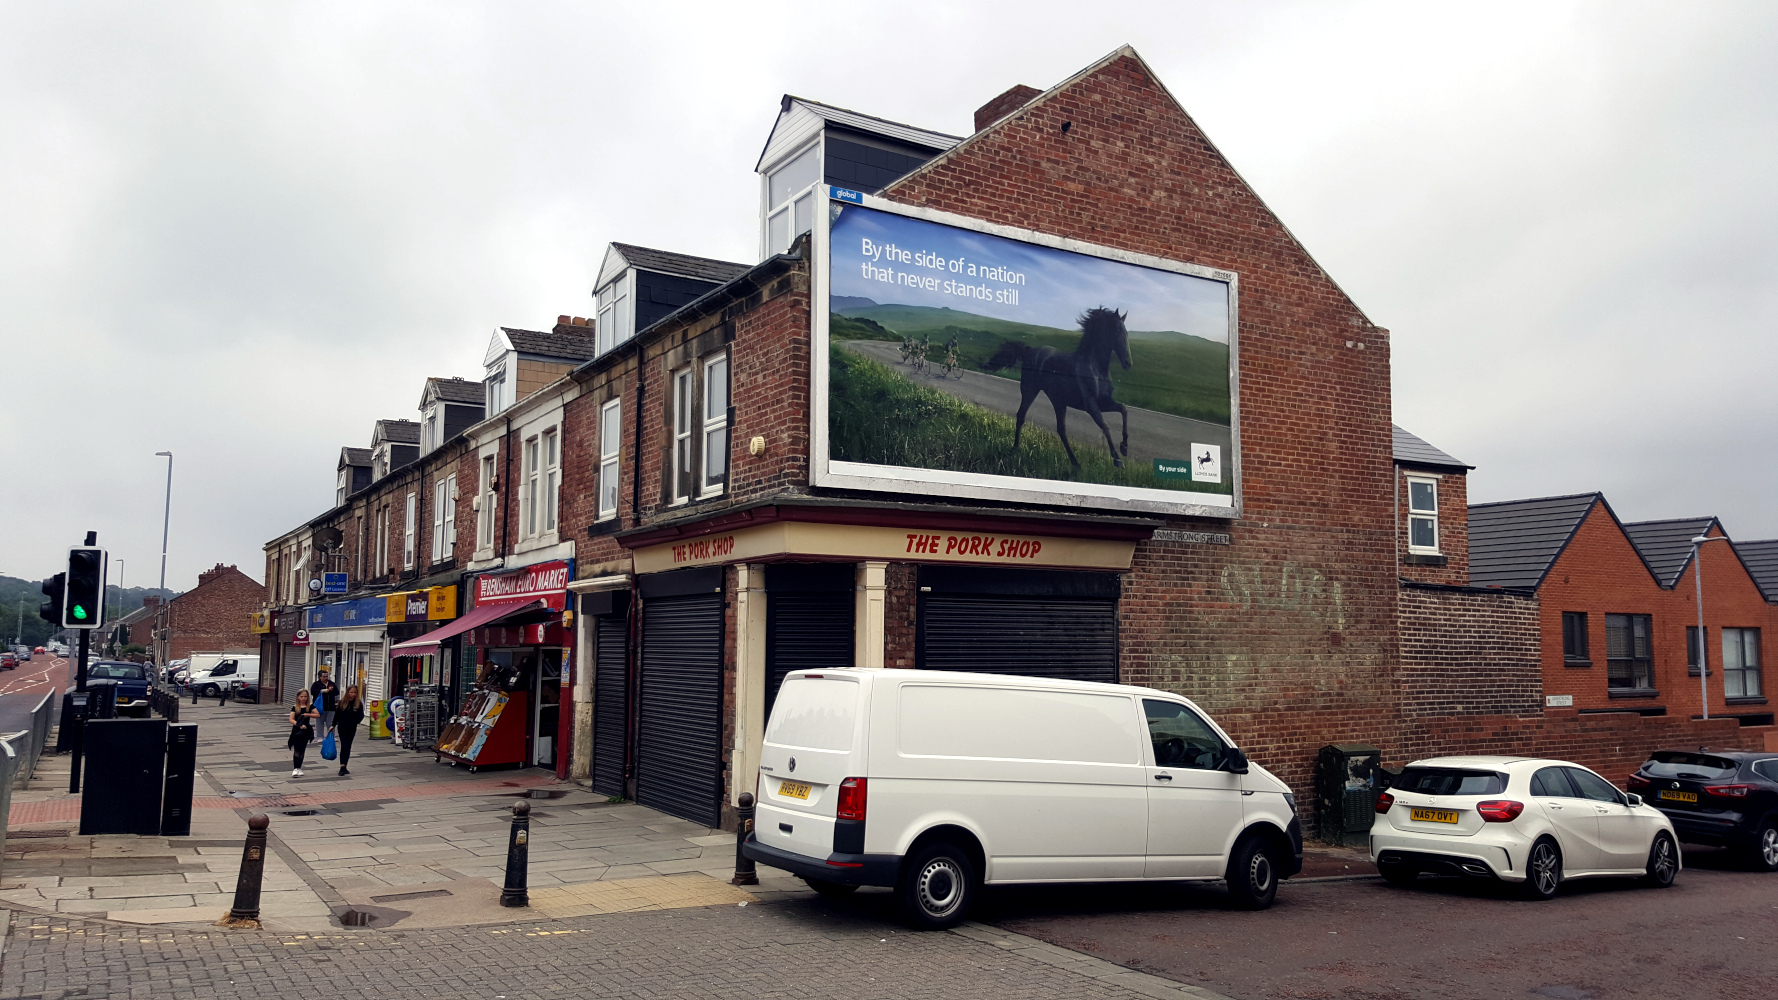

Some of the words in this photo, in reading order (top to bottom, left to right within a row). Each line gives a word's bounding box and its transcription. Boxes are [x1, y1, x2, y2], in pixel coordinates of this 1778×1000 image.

[837, 190, 857, 199] global
[862, 238, 882, 261] By
[885, 244, 911, 264] the
[915, 250, 945, 270] side
[949, 257, 965, 273] of
[967, 263, 977, 277] a
[980, 266, 1025, 285] nation
[861, 262, 894, 284] that
[898, 271, 941, 291] never
[944, 280, 993, 301] stands
[996, 288, 1019, 305] still
[1158, 464, 1165, 472] By
[906, 534, 941, 554] THE
[945, 536, 995, 556] PORK
[997, 538, 1042, 558] SHOP
[1152, 531, 1199, 542] ARMSTRONG
[1201, 534, 1228, 543] STREET
[672, 544, 687, 563] THE
[688, 540, 710, 560] PORK
[713, 535, 735, 557] SHOP
[516, 572, 536, 592] EURO
[536, 567, 568, 590] MARKET
[407, 599, 428, 616] Premier
[1413, 809, 1435, 820] NA67
[1437, 811, 1454, 821] OVT
